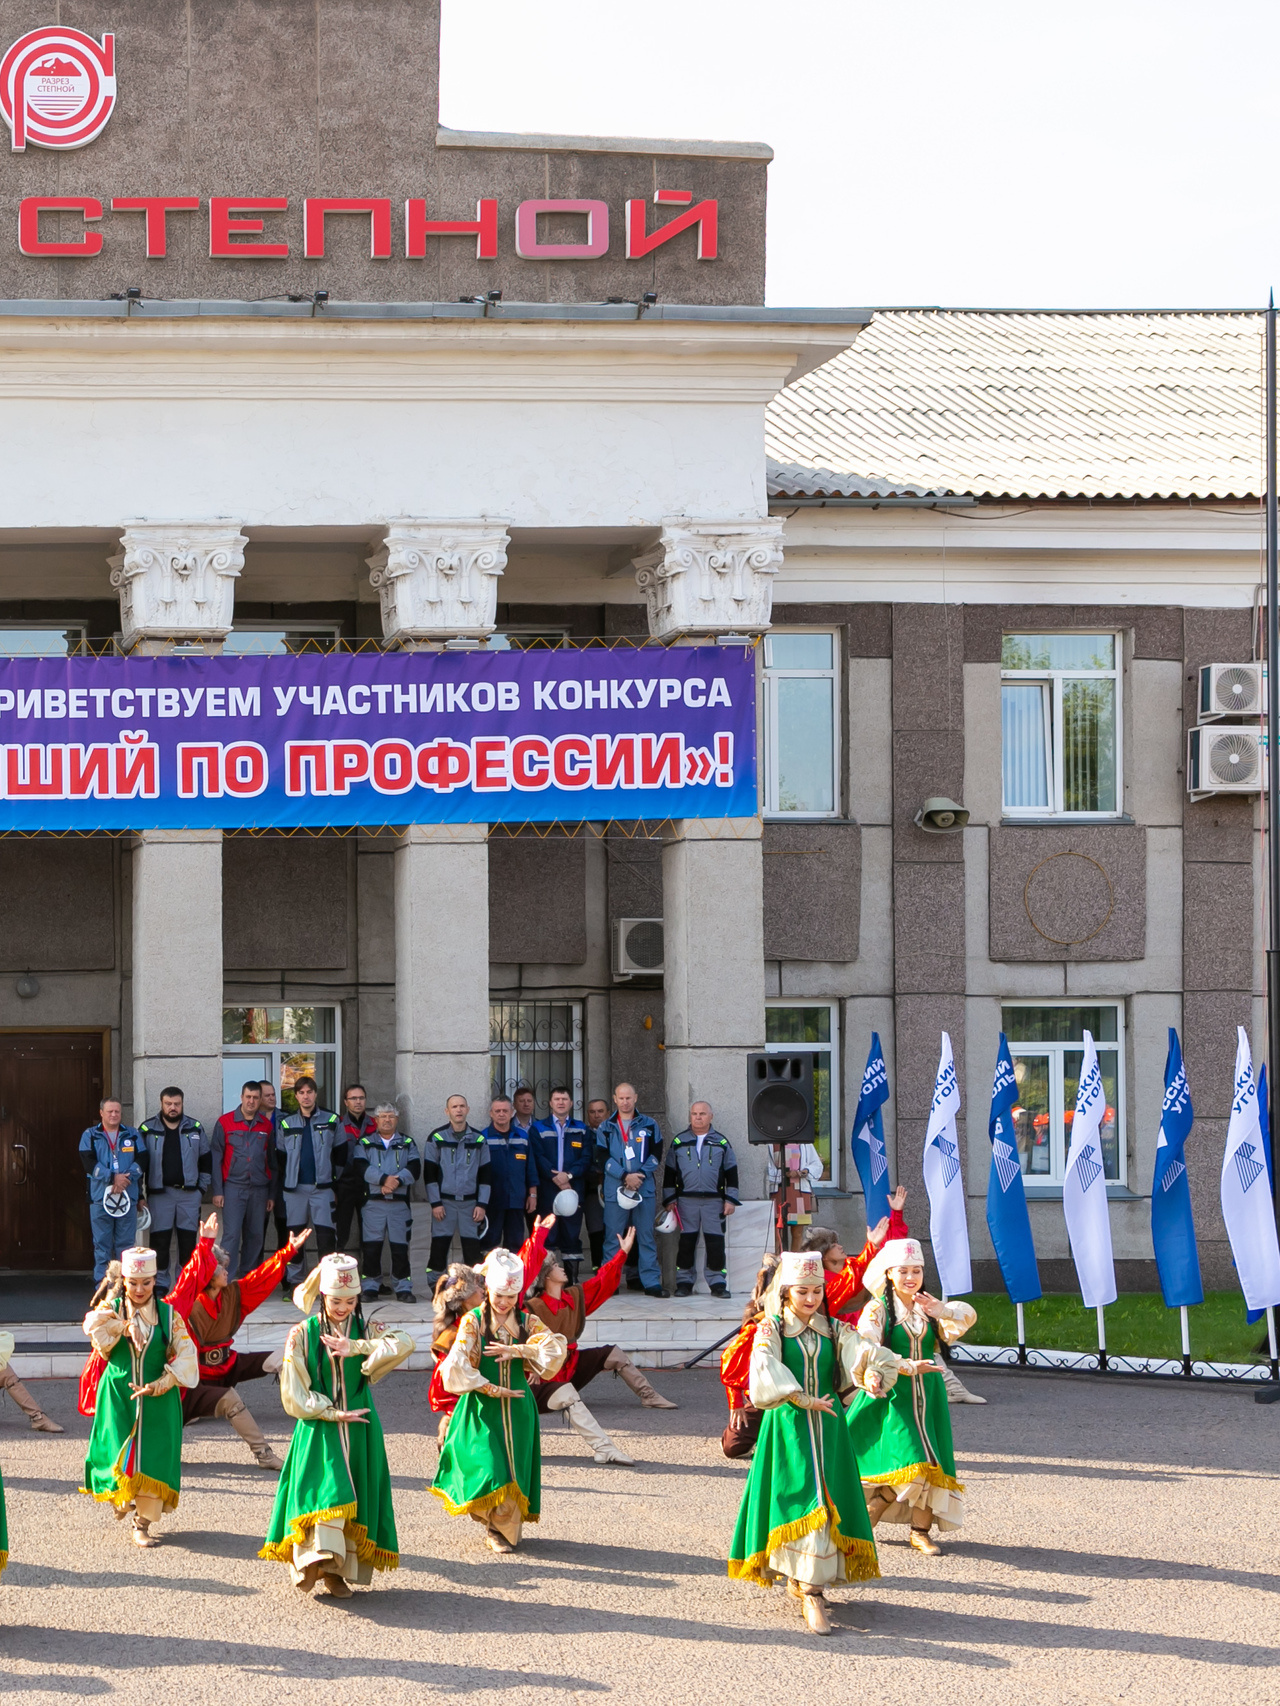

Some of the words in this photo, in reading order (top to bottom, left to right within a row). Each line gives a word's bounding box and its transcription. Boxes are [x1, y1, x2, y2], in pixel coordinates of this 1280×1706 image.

[37, 84, 75, 93] СТЕПНОЙ
[41, 77, 70, 85] РАЗРЕЗ
[19, 190, 718, 260] СТЕПНОЙ
[273, 679, 521, 716] УЧАСТНИКОВ
[533, 677, 733, 711] КОНКУРСА
[176, 741, 269, 798] ПО
[285, 731, 734, 797] ПРОФЕССИИ»!
